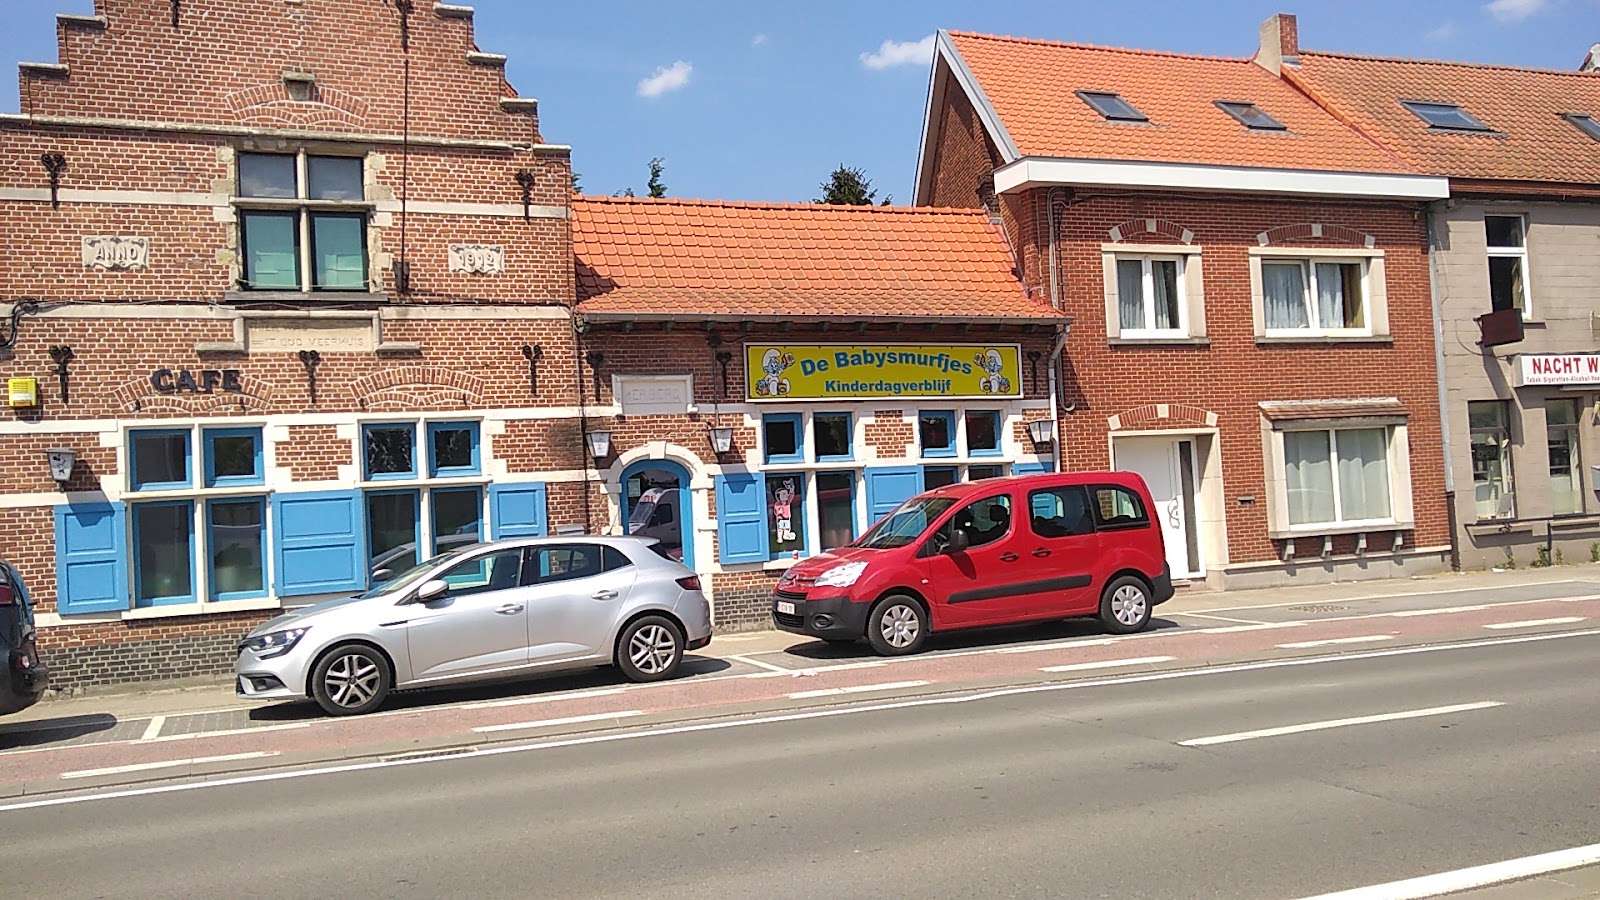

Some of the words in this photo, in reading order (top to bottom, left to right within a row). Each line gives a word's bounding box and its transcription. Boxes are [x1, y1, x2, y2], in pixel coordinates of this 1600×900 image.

[97, 244, 138, 261] ANNO
[459, 252, 494, 267] 1912
[801, 360, 828, 376] De
[835, 349, 972, 375] Babysmurfjes
[1532, 357, 1581, 374] NACHT
[153, 369, 241, 393] CAFE
[825, 380, 951, 394] Kinderdagverblijf
